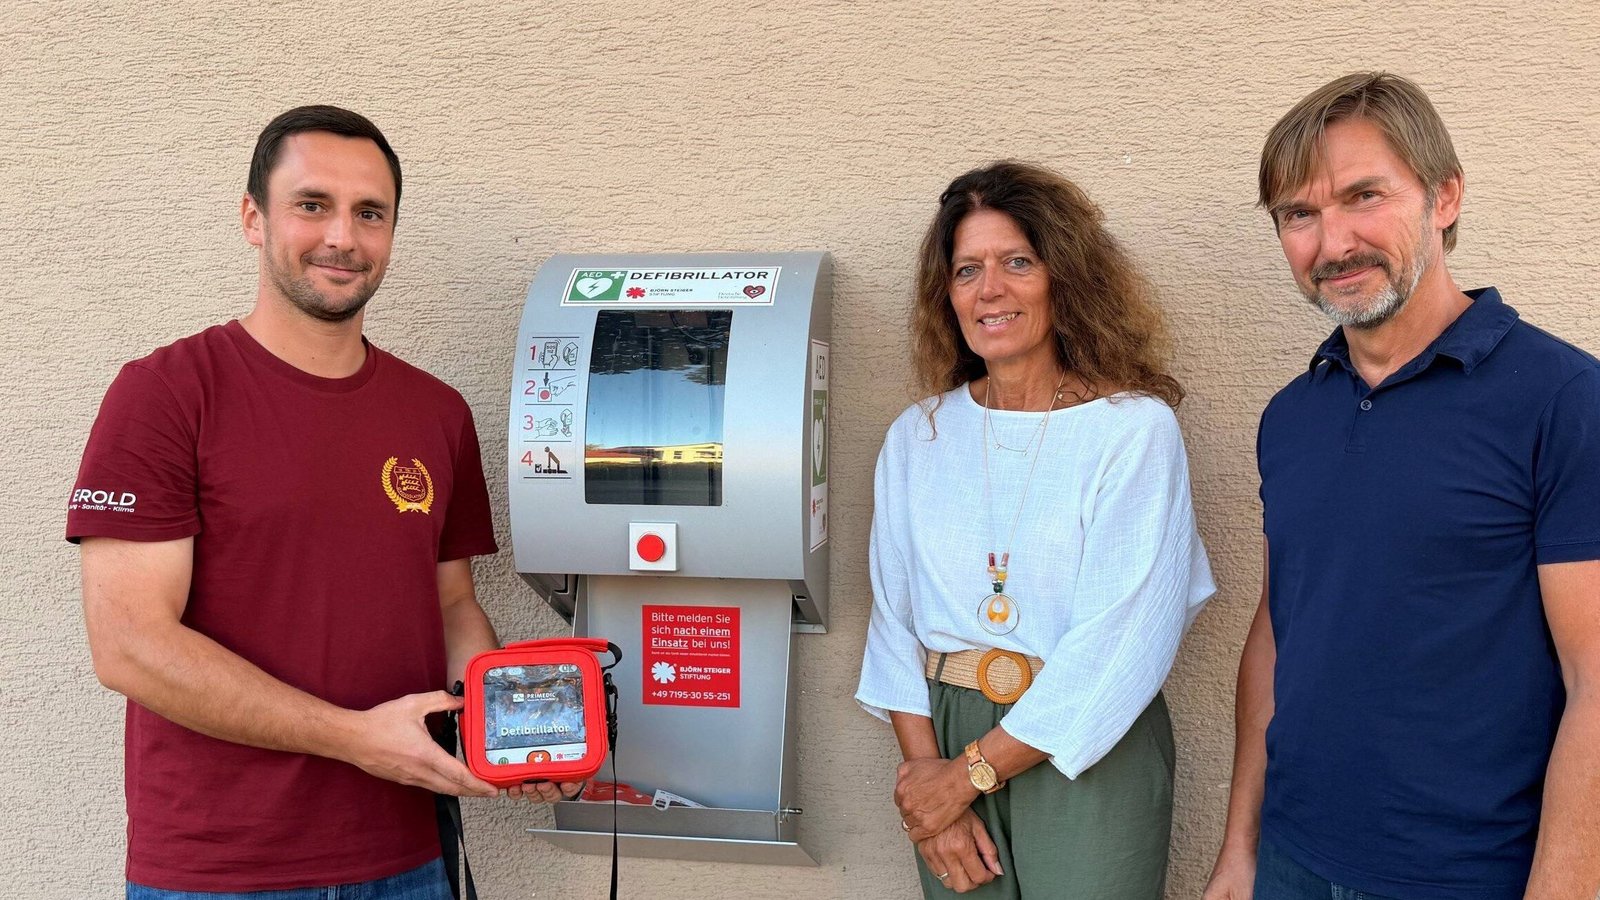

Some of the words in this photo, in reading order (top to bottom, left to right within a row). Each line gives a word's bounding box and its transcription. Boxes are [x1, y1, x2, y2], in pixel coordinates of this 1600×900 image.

[630, 271, 769, 280] DEFIBRILLATOR
[530, 345, 537, 360] 1
[524, 380, 536, 395] 2
[523, 414, 534, 430] 3
[521, 450, 533, 466] 4
[82, 503, 107, 511] Sanitär
[651, 612, 674, 622] Bitte
[677, 613, 713, 623] melden
[715, 614, 731, 624] Sie
[651, 625, 671, 634] sich
[673, 626, 697, 635] nach
[700, 627, 731, 636] einem
[651, 637, 688, 647] Einsatz
[692, 639, 707, 648] bei
[710, 640, 731, 649] uns!
[652, 690, 668, 698] +49
[669, 690, 702, 699] 7195-30
[703, 692, 731, 700] 55-251
[501, 724, 570, 737] Defibrillator
